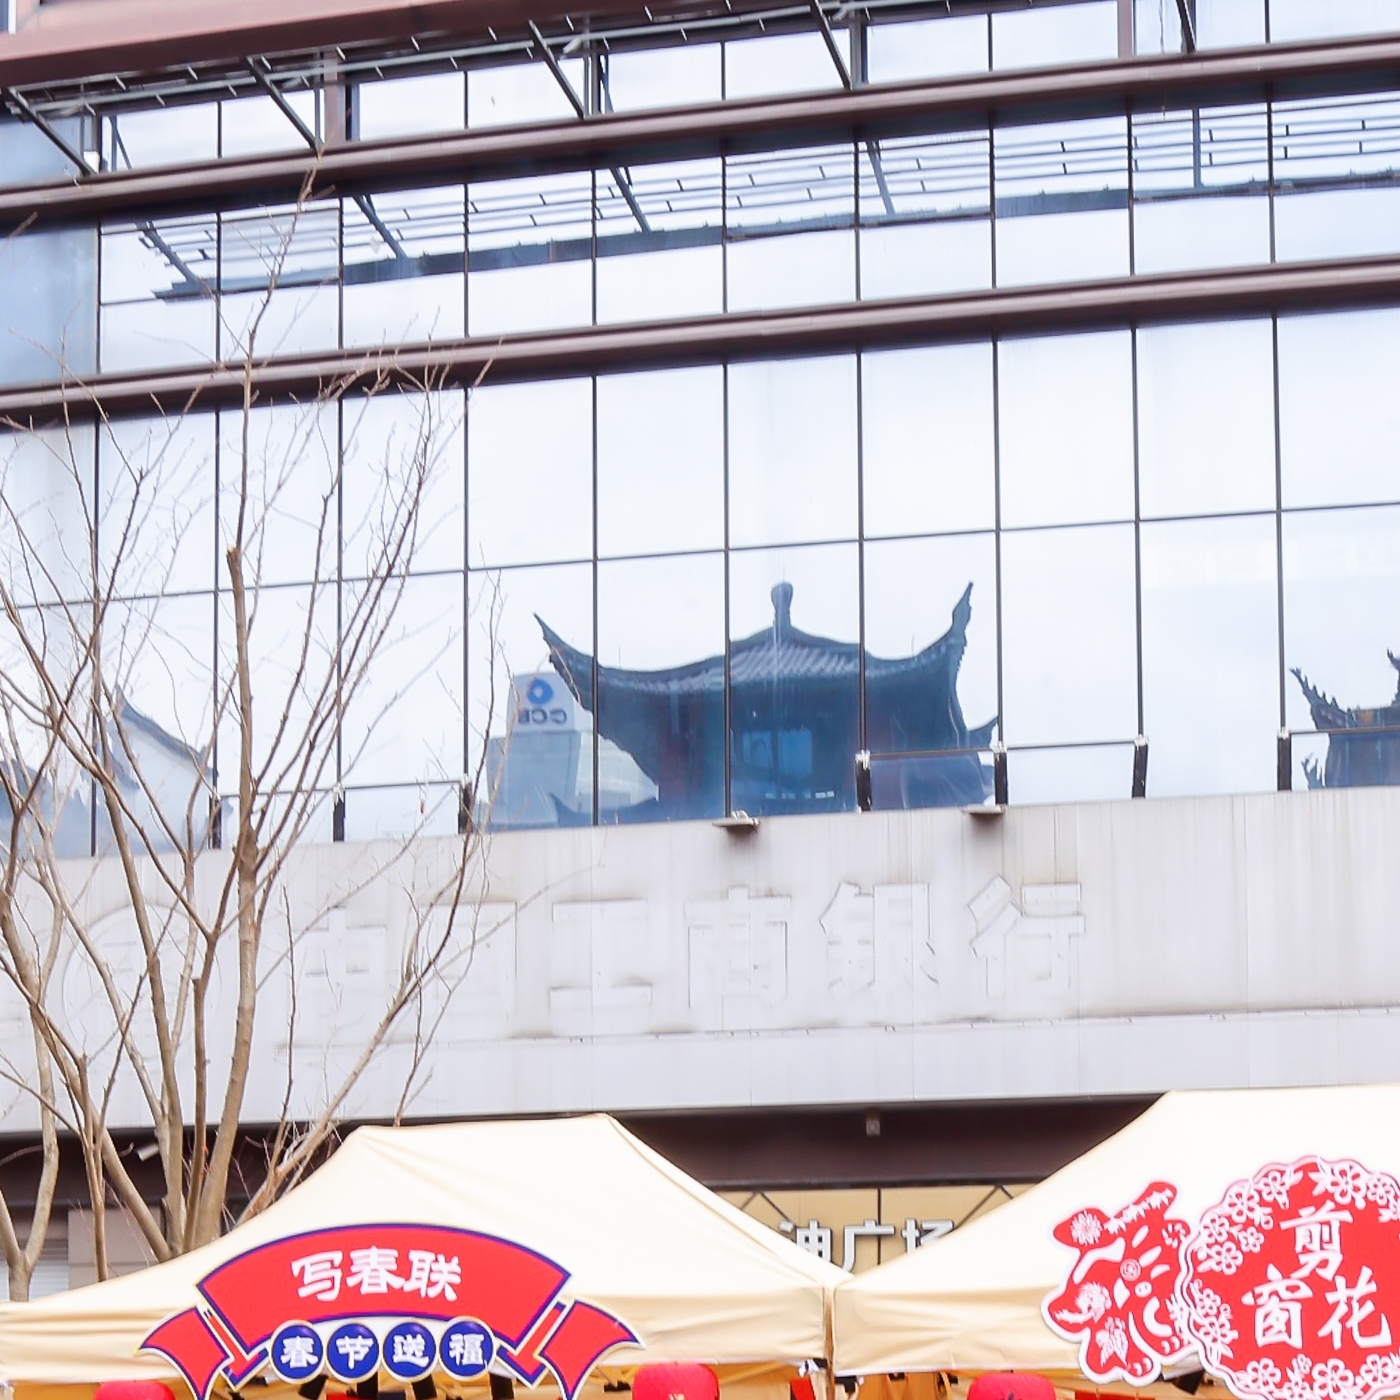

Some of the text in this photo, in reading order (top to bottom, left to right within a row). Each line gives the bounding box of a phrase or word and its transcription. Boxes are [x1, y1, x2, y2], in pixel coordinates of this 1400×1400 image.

[291, 1246, 461, 1302] 写春联
[1279, 1200, 1354, 1281] 剪
